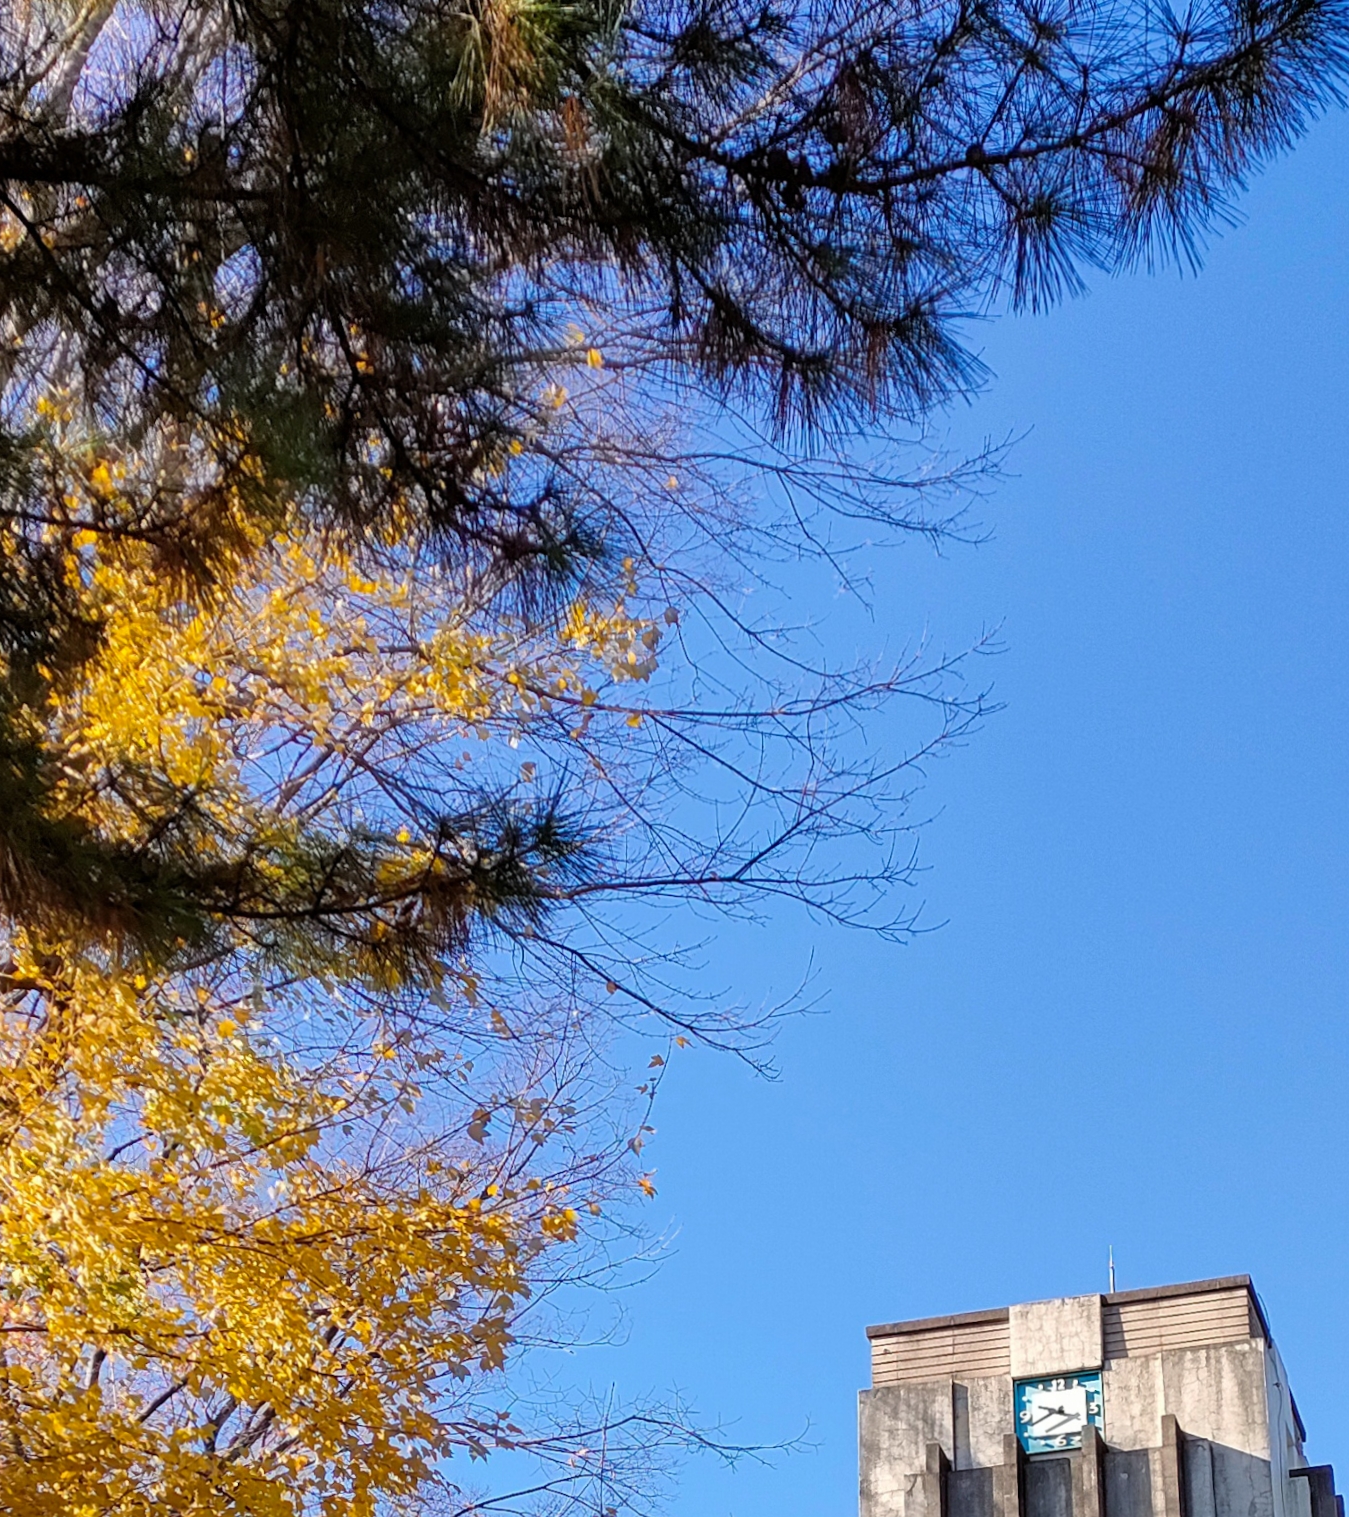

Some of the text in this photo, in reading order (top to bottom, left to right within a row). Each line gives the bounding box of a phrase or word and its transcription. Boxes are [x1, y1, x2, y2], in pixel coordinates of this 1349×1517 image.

[1051, 1378, 1066, 1391] 12
[1088, 1402, 1099, 1414] 3
[1019, 1410, 1031, 1424] 9
[1055, 1434, 1067, 1446] 6
